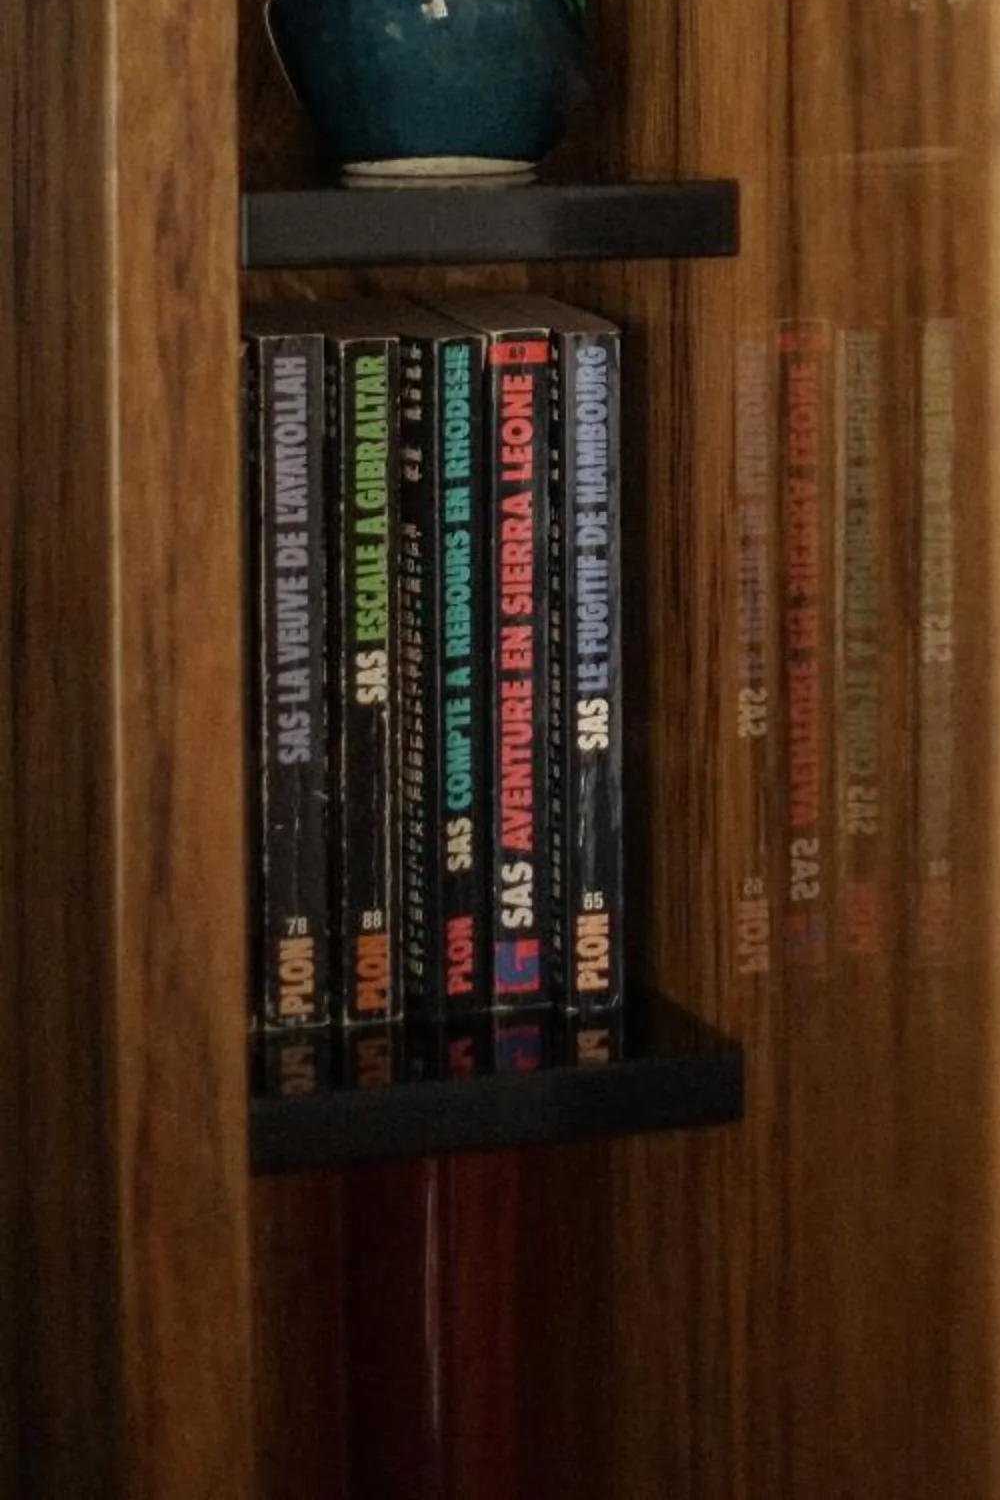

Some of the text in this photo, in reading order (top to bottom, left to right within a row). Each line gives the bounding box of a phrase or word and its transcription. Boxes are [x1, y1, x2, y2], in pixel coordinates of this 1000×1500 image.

[273, 355, 311, 765] SAS LA VEUVE DE L'AYATOLLAH
[355, 354, 389, 705] SAS ESCALE A GIBRALTAR
[444, 343, 474, 873] SAS COMPTE A REBOURS EN RHODESIE
[501, 373, 534, 929] SAS AVENTURE EN SIERRA LEONE
[575, 345, 610, 752] SAS LE FUGITIF DE HAMBOURG
[279, 938, 315, 1015] PLON
[447, 915, 474, 995] PLON
[575, 913, 610, 992] PLON
